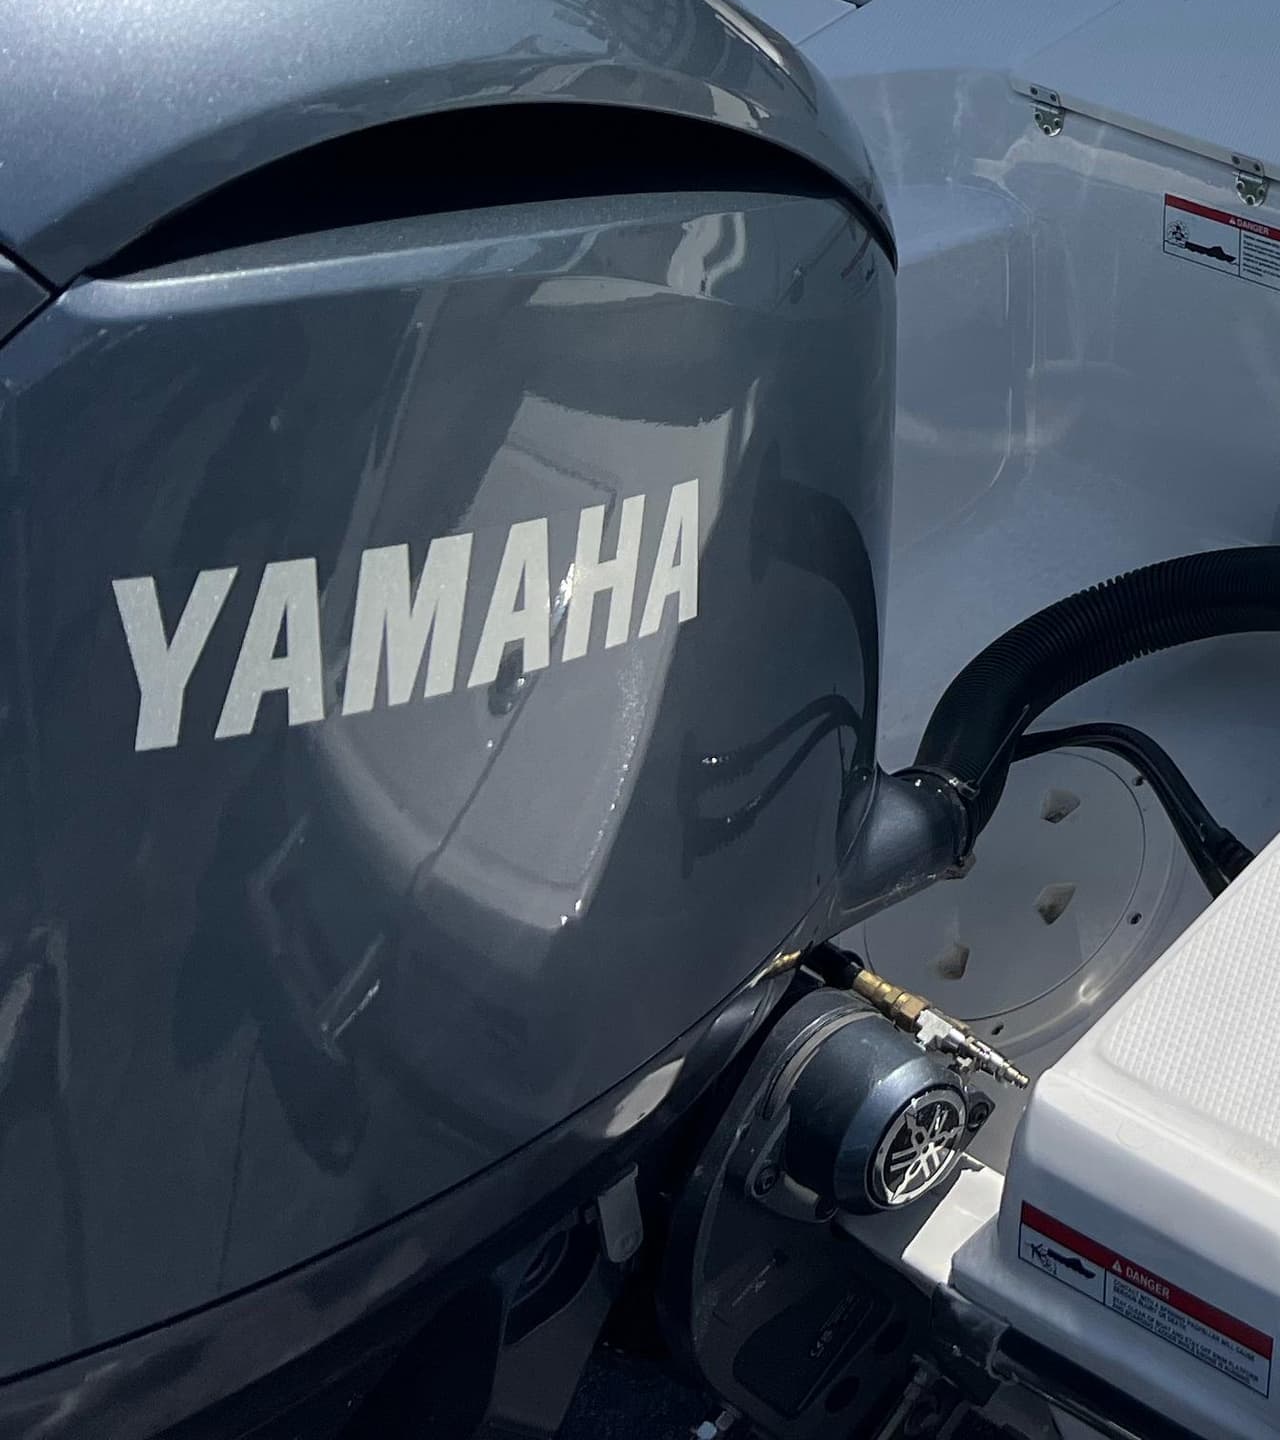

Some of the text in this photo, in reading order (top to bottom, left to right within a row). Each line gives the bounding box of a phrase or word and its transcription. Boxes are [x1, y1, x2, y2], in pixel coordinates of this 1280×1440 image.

[1236, 217, 1270, 236] DANGER
[112, 478, 698, 753] YAMAHA
[1126, 1266, 1170, 1300] DANGER
